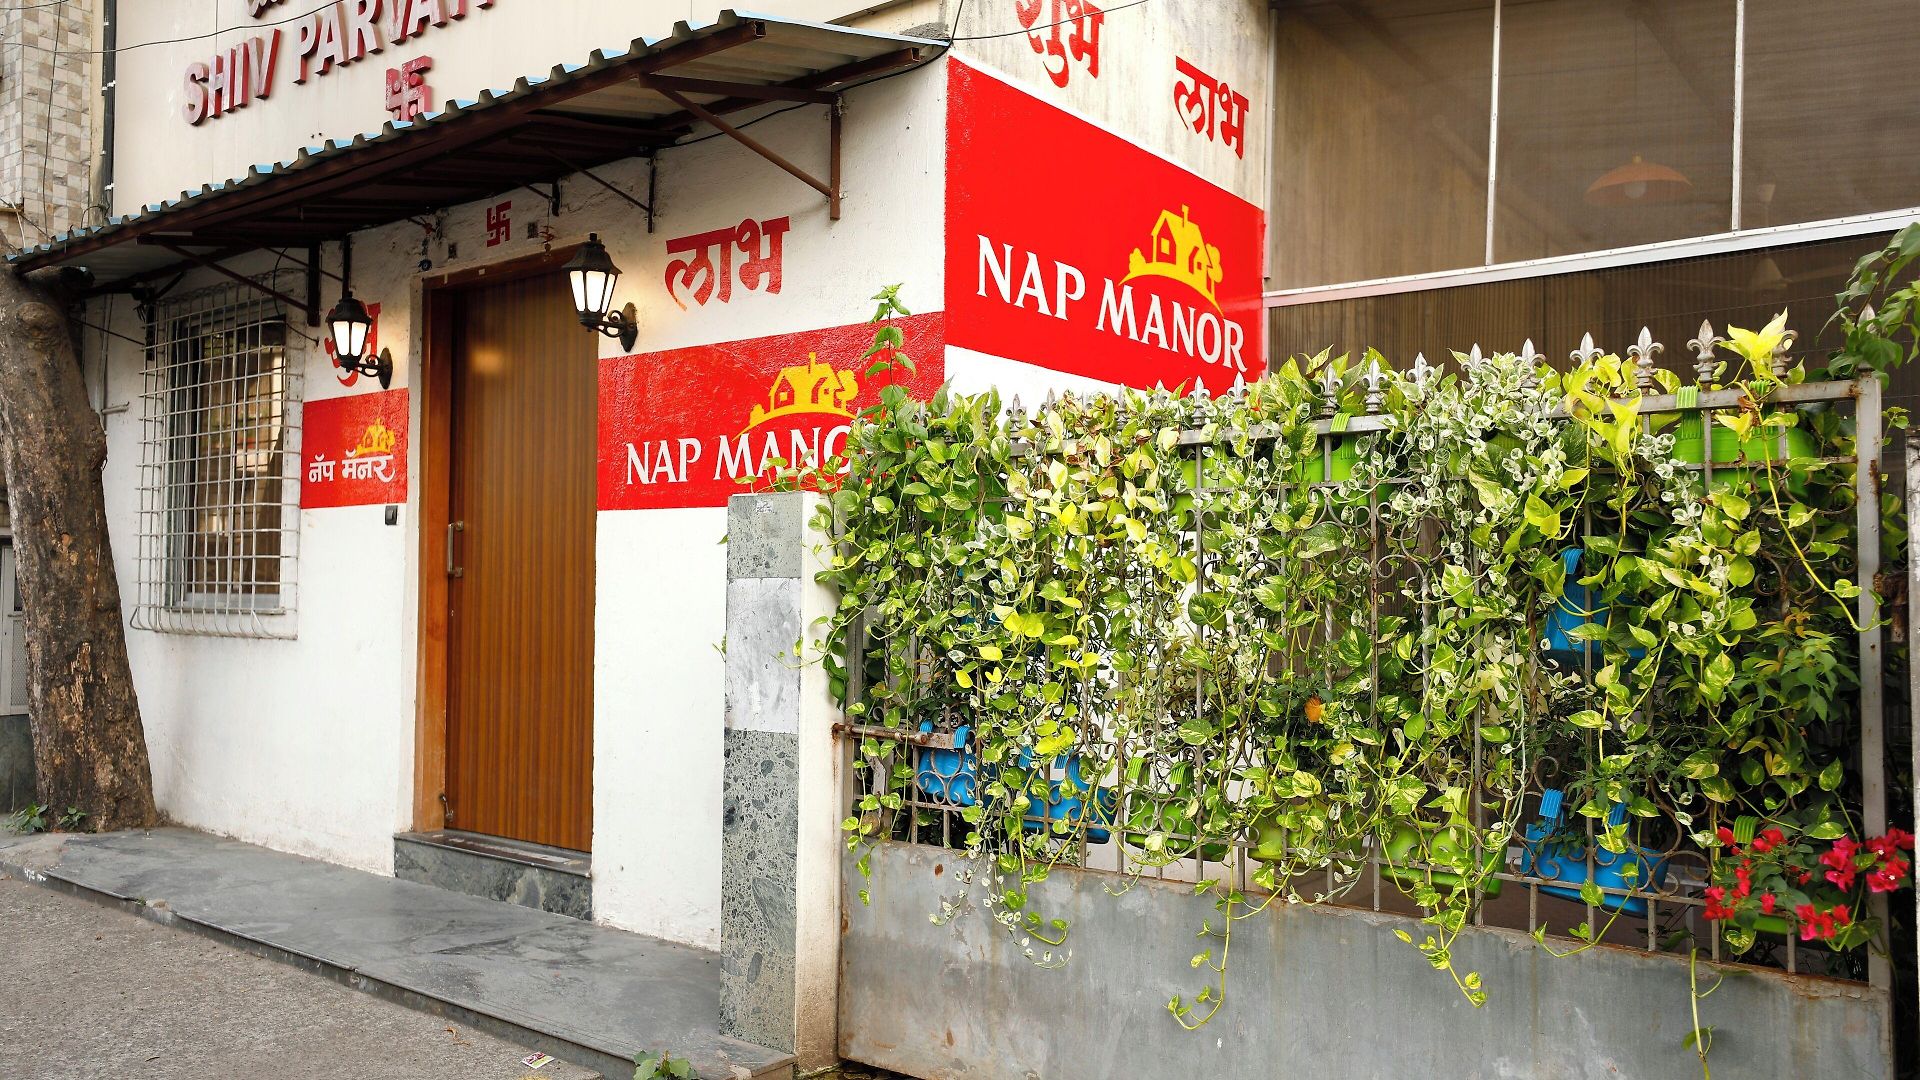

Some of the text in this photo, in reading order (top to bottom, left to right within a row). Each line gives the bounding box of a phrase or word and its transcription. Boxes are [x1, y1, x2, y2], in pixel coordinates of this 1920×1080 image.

[183, 0, 493, 126] SHIV PARVA
[1174, 56, 1249, 160] लाभ
[665, 216, 790, 311] लाभ
[976, 235, 1247, 371] NAP MANOR
[308, 453, 336, 483] नॅप
[627, 425, 852, 485] NAP MANO
